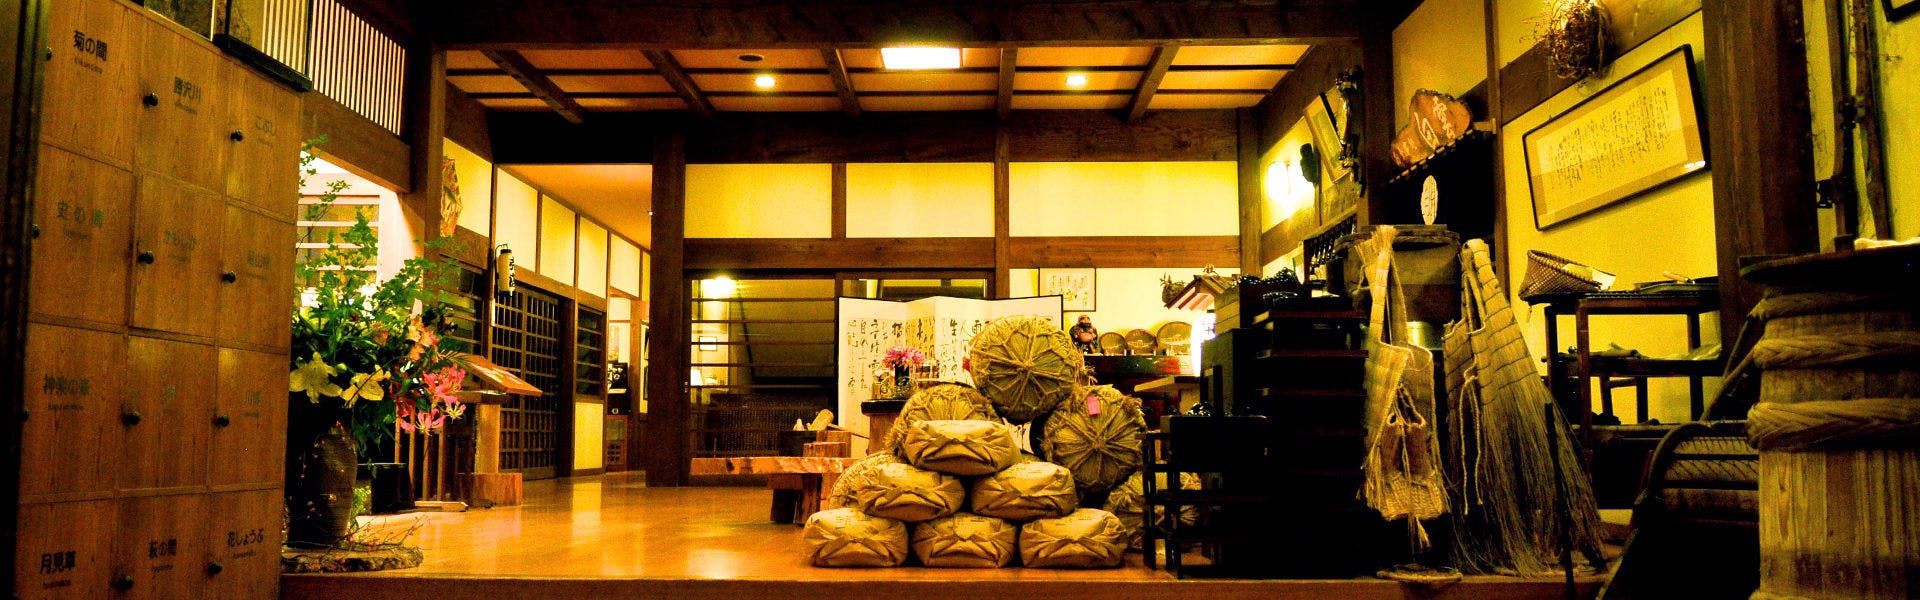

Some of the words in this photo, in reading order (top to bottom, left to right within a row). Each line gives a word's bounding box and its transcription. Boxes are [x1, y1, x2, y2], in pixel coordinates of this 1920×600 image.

[73, 30, 107, 61] 菊の間
[227, 528, 264, 548] 花しょうぶ
[39, 550, 77, 575] 月見草
